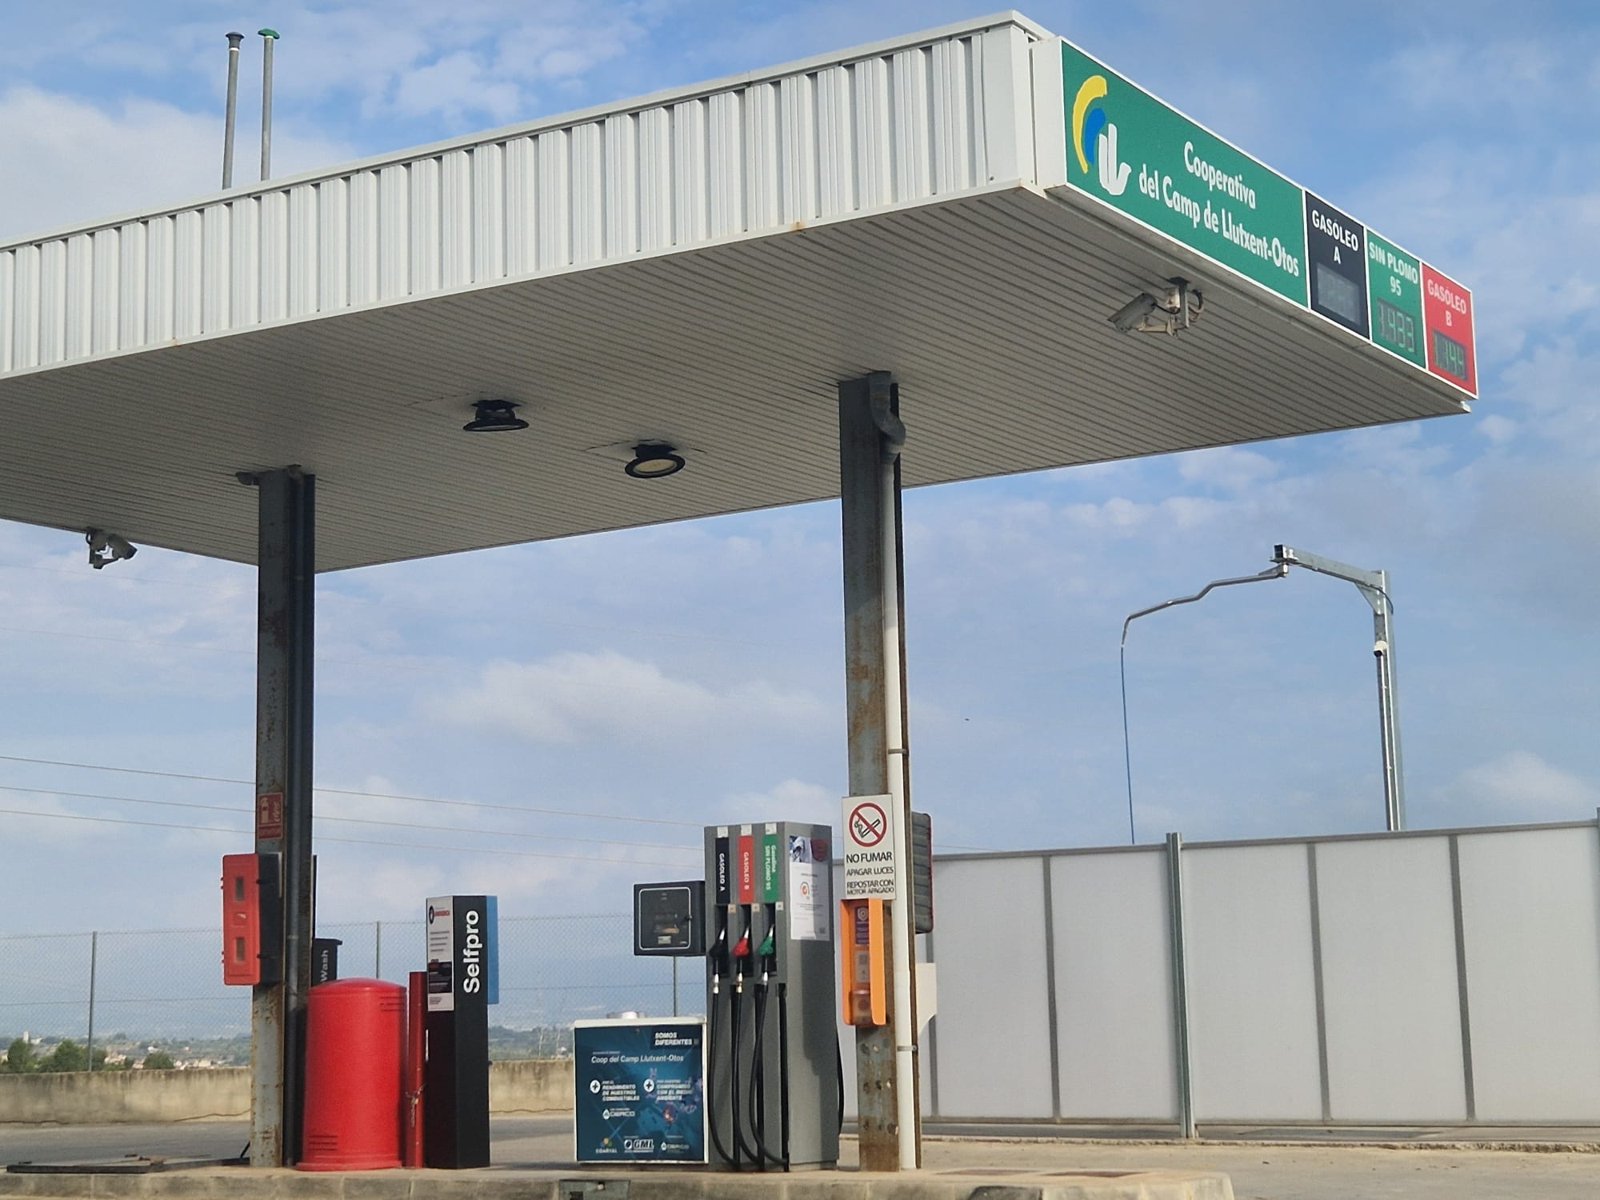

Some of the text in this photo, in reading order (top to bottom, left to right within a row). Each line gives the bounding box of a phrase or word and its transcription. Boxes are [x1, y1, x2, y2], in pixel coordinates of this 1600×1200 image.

[1184, 141, 1256, 209] Cooperativa
[1139, 163, 1299, 277] del Camp de Llutxent-Otos
[1333, 246, 1341, 265] A
[1369, 241, 1419, 285] SIN PLOMO
[1390, 275, 1402, 297] 95
[1445, 310, 1452, 327] B
[846, 852, 893, 863] NO FUMAR
[874, 867, 894, 875] LUCES
[847, 879, 894, 889] REPOSTAR CON
[463, 911, 482, 993] Selfpro
[591, 1056, 608, 1064] Coop
[609, 1055, 619, 1063] del
[620, 1055, 639, 1064] Camp
